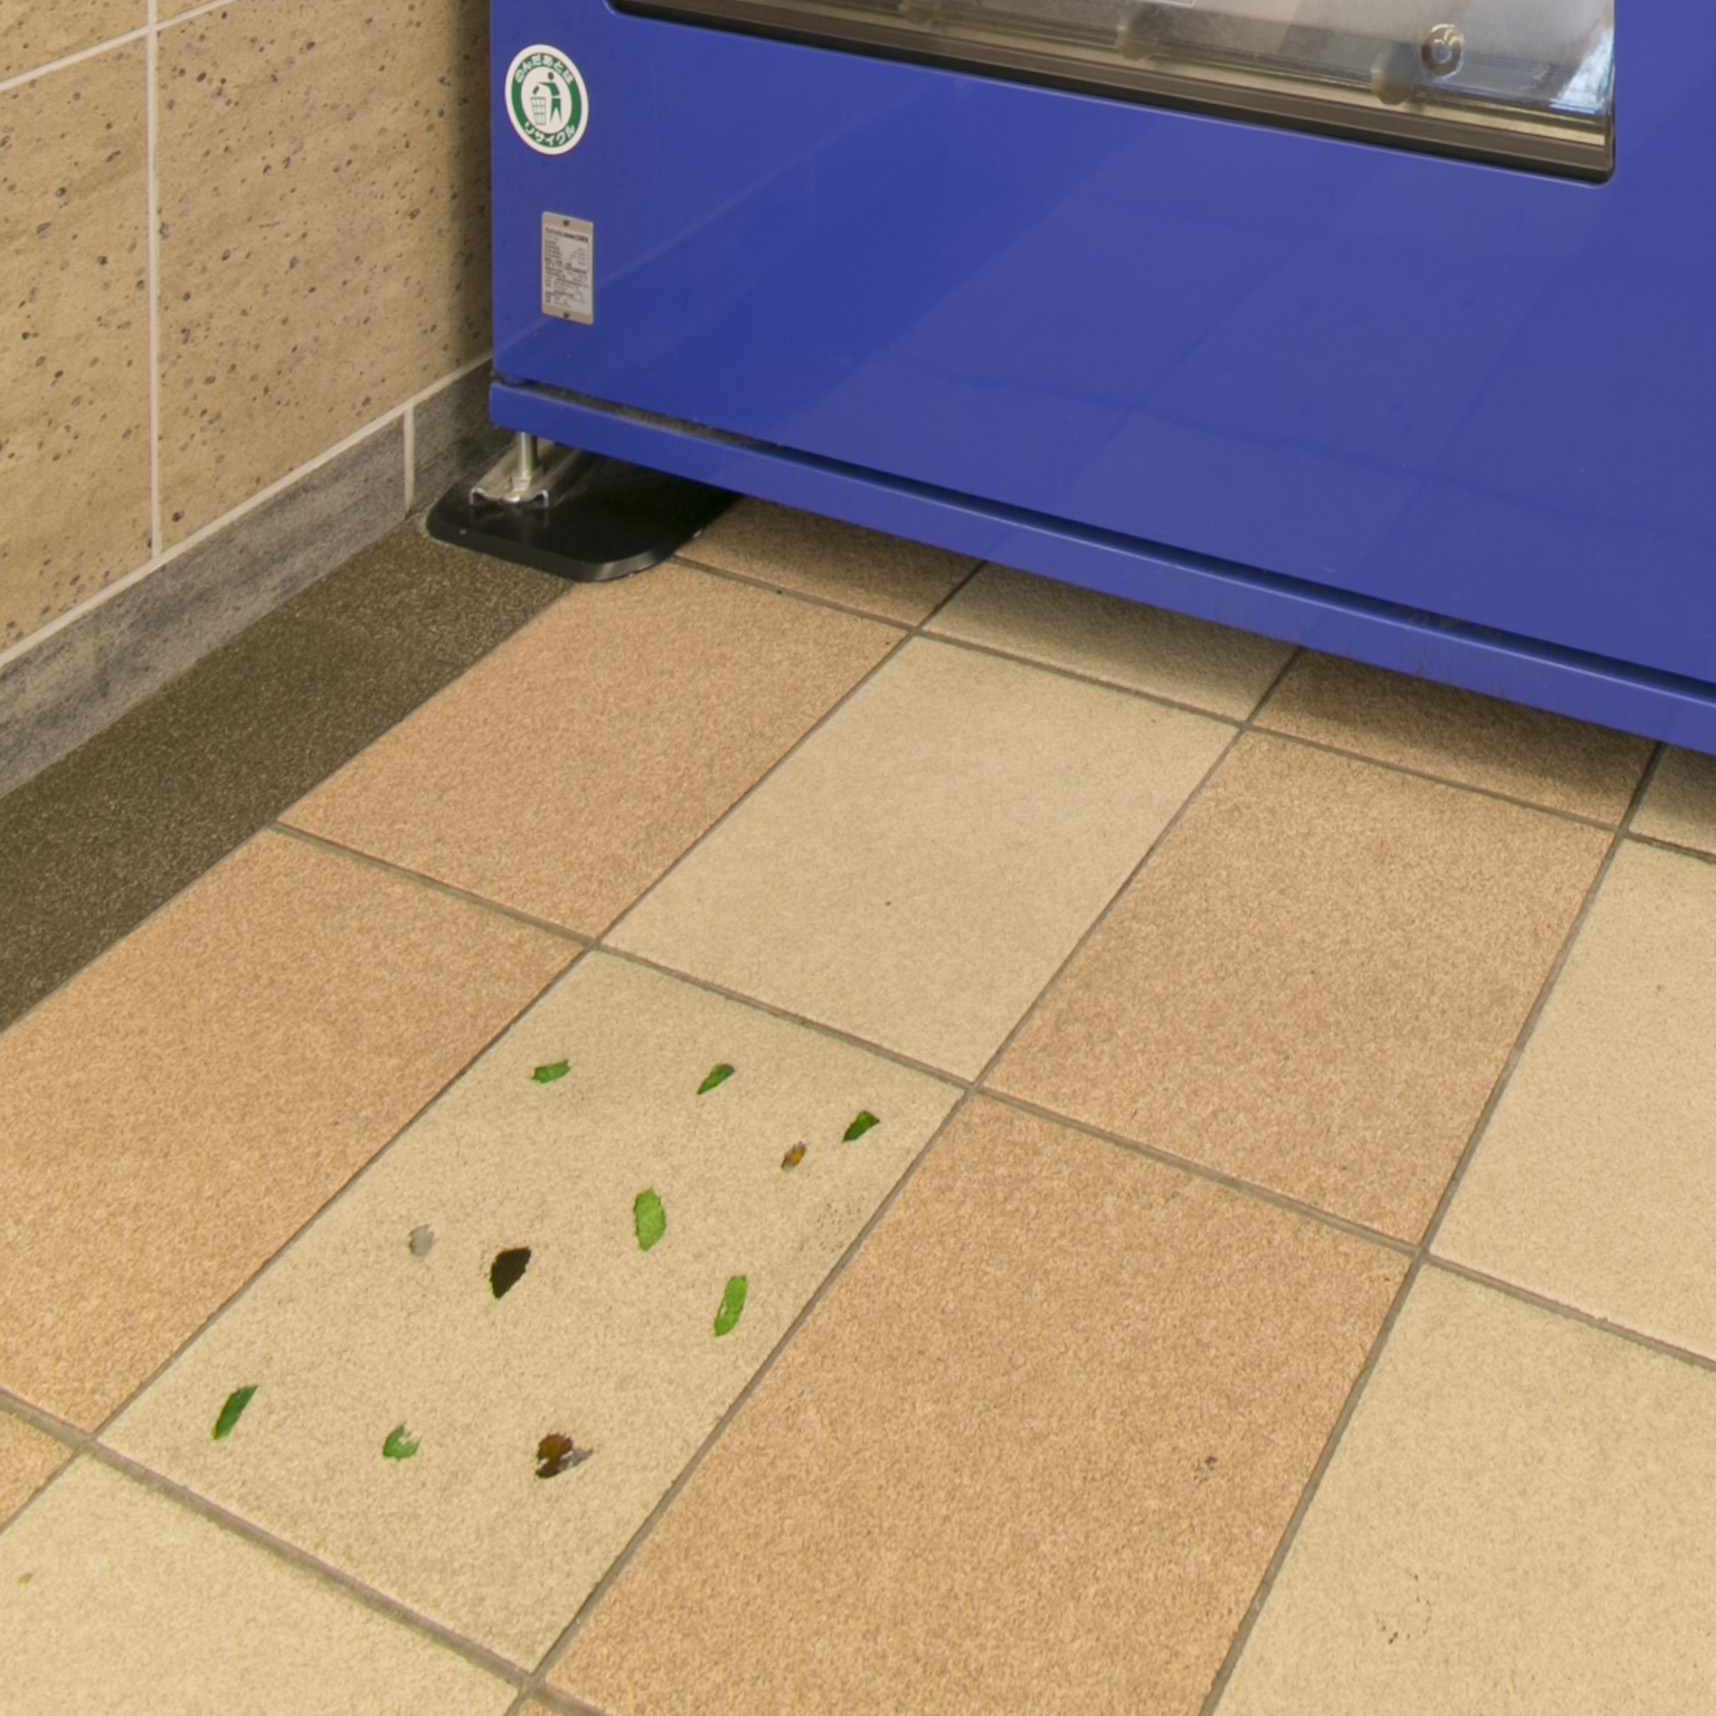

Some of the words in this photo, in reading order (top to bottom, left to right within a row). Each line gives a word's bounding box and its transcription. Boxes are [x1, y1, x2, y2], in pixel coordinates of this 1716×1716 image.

[514, 54, 574, 84] のんだあとは
[524, 121, 576, 146] リサイクル
